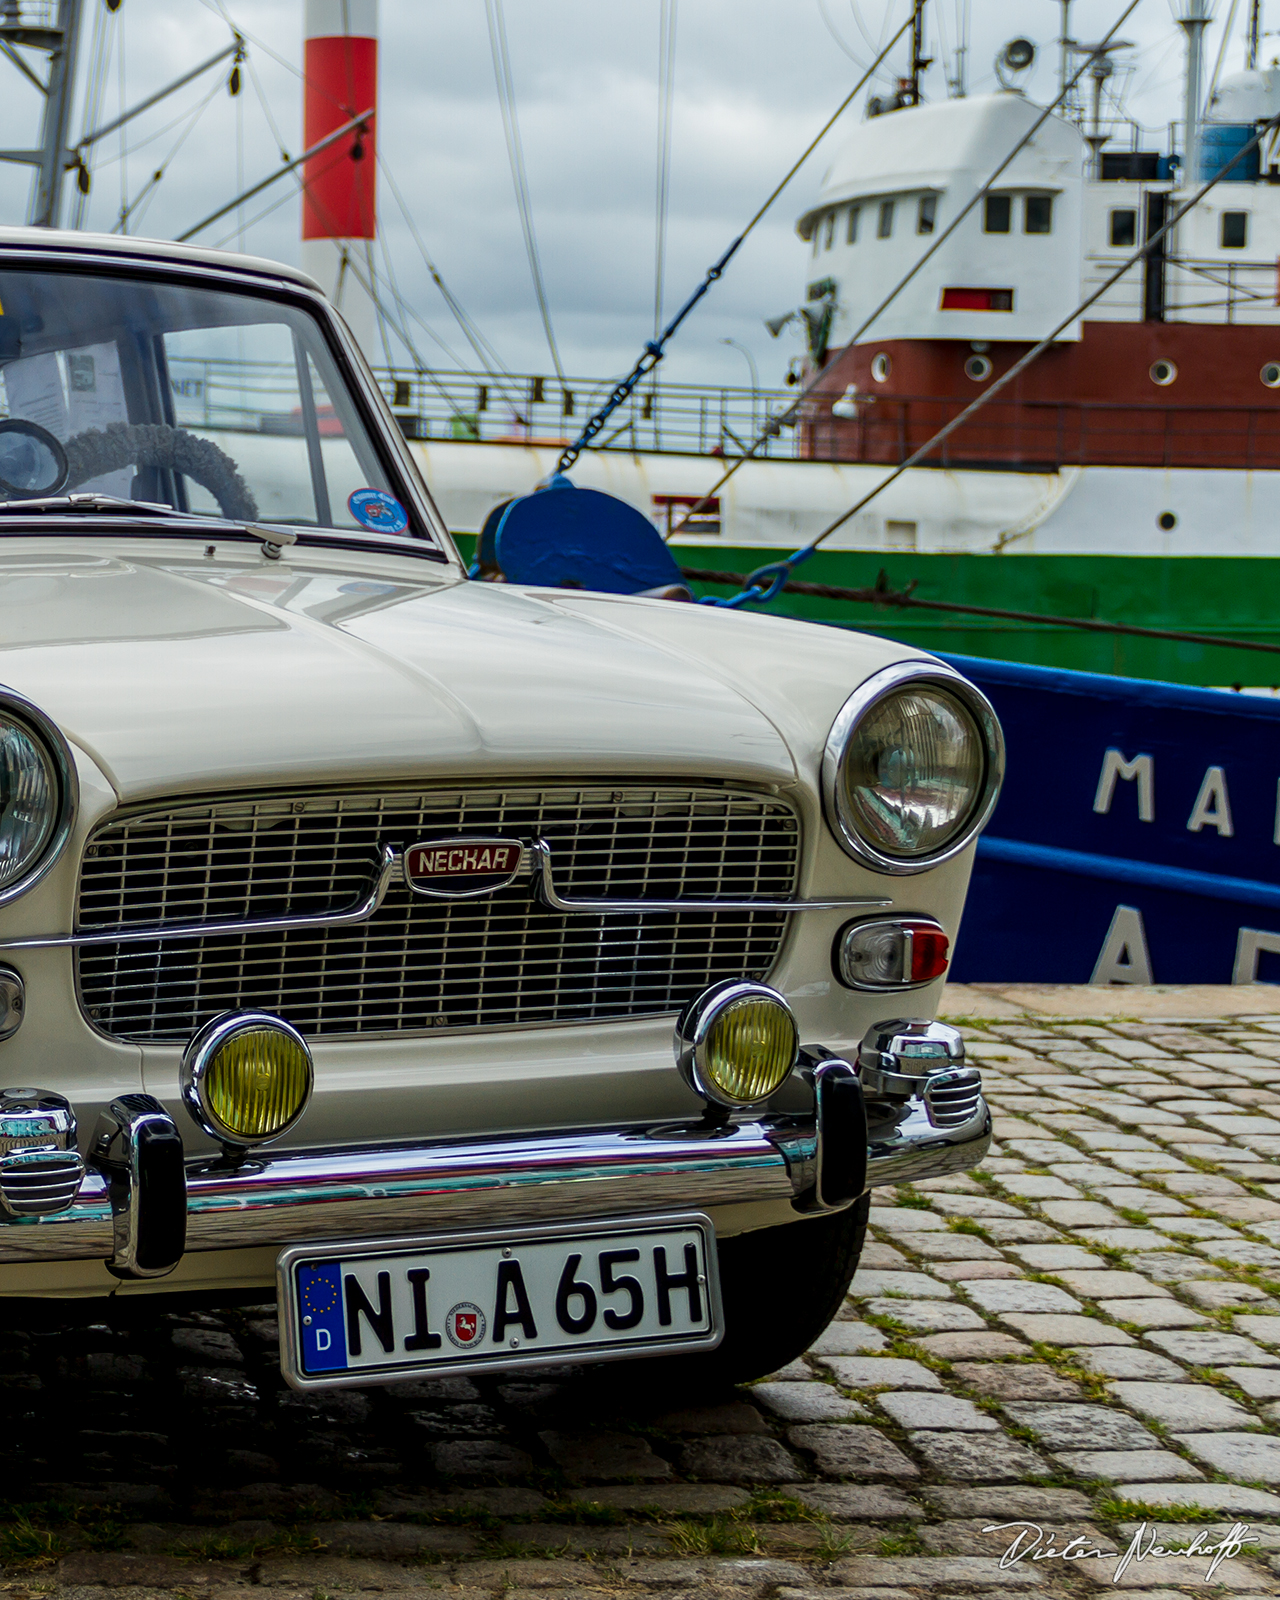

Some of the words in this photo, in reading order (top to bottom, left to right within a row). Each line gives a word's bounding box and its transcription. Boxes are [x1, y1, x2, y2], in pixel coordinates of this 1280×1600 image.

[1092, 746, 1280, 846] MA
[418, 847, 510, 873] NECKAR
[316, 1328, 332, 1352] D
[344, 1265, 442, 1357] NI
[492, 1258, 538, 1343] A
[554, 1242, 703, 1335] 65H
